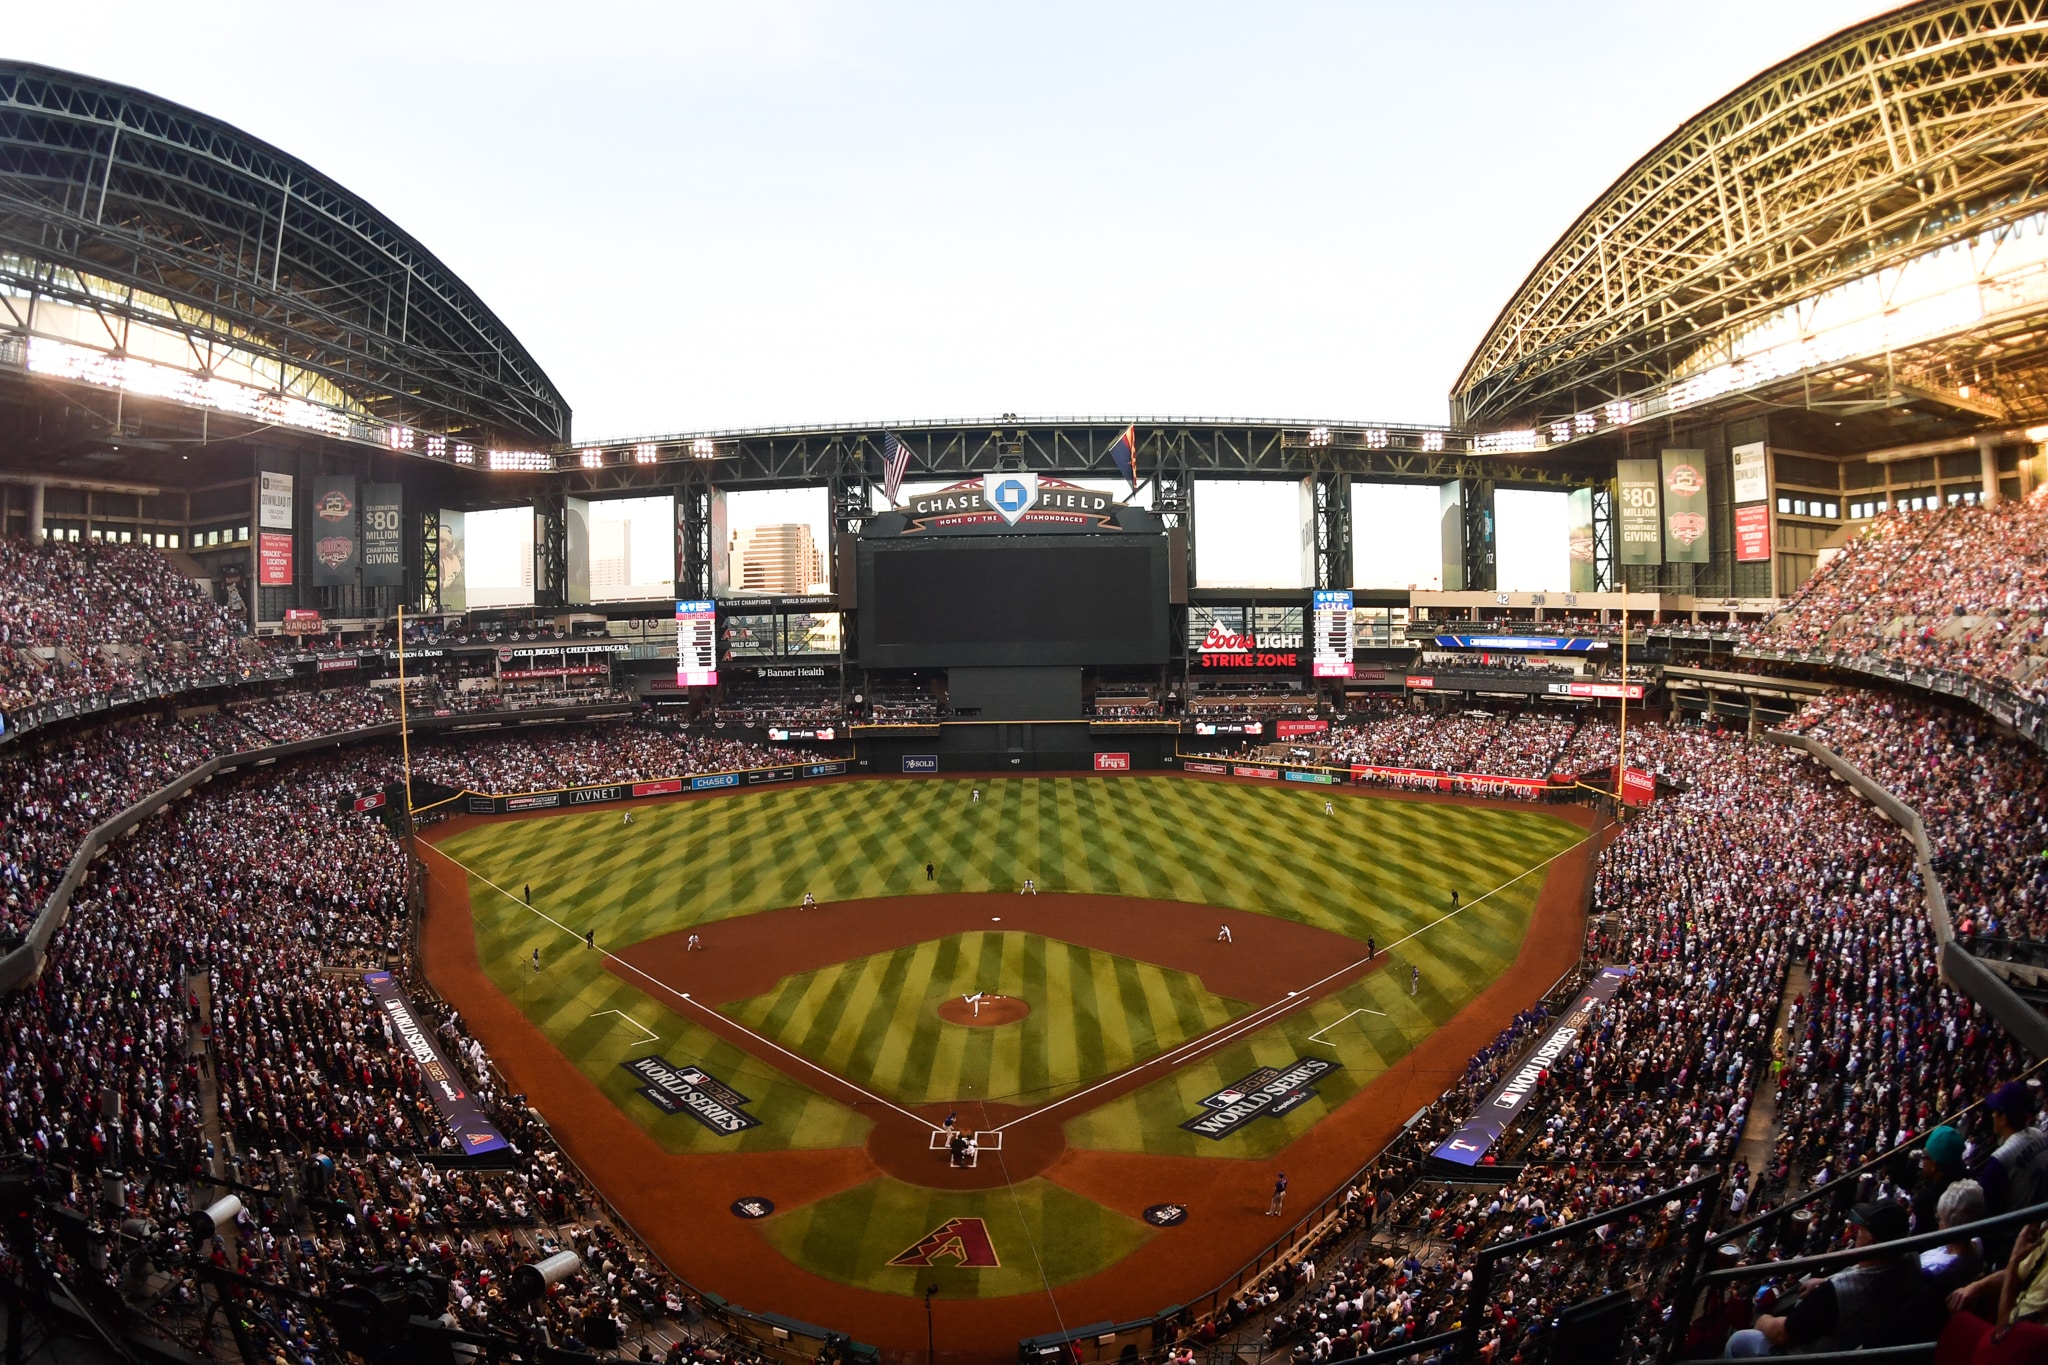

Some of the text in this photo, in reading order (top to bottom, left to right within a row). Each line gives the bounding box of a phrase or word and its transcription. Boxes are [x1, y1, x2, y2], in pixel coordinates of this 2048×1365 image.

[1676, 471, 1693, 486] 25
[326, 497, 342, 511] 25
[917, 493, 1106, 514] CHASE FIELD
[1622, 487, 1656, 507] $80
[1026, 514, 1083, 523] DIAMONDBACKS
[1623, 508, 1657, 517] MILLION
[366, 511, 399, 530] $80
[366, 531, 399, 540] MILLION
[1624, 531, 1657, 542] GIVING
[366, 546, 399, 554] CHARITABLE
[366, 553, 399, 565] GIVING
[1318, 602, 1349, 610] TEXAS
[1496, 594, 1509, 605] 42
[1531, 594, 1546, 606] 20
[286, 621, 321, 631] SANDLOT
[1202, 628, 1302, 649] Coors LIGHT
[425, 649, 443, 657] BONES
[514, 649, 534, 657] COLD
[535, 647, 559, 656] BEERS
[566, 644, 629, 654] CHEESEBURGERS
[1201, 653, 1297, 667] STRIKE ZONE
[767, 667, 825, 677] Banner Health
[1098, 754, 1126, 768] fry's
[697, 777, 725, 787] CHASE
[575, 788, 616, 802] AVNET
[389, 1006, 414, 1038] WORLD
[406, 1032, 439, 1064] SERIES
[426, 1062, 446, 1081] 2023
[1505, 1057, 1551, 1093] WORLD
[1538, 1026, 1577, 1060] SERIES
[1236, 1070, 1279, 1093] 2023
[635, 1058, 747, 1131] WORLD SERIES
[700, 1082, 739, 1105] 2023
[1193, 1060, 1329, 1133] WORLD SERIES
